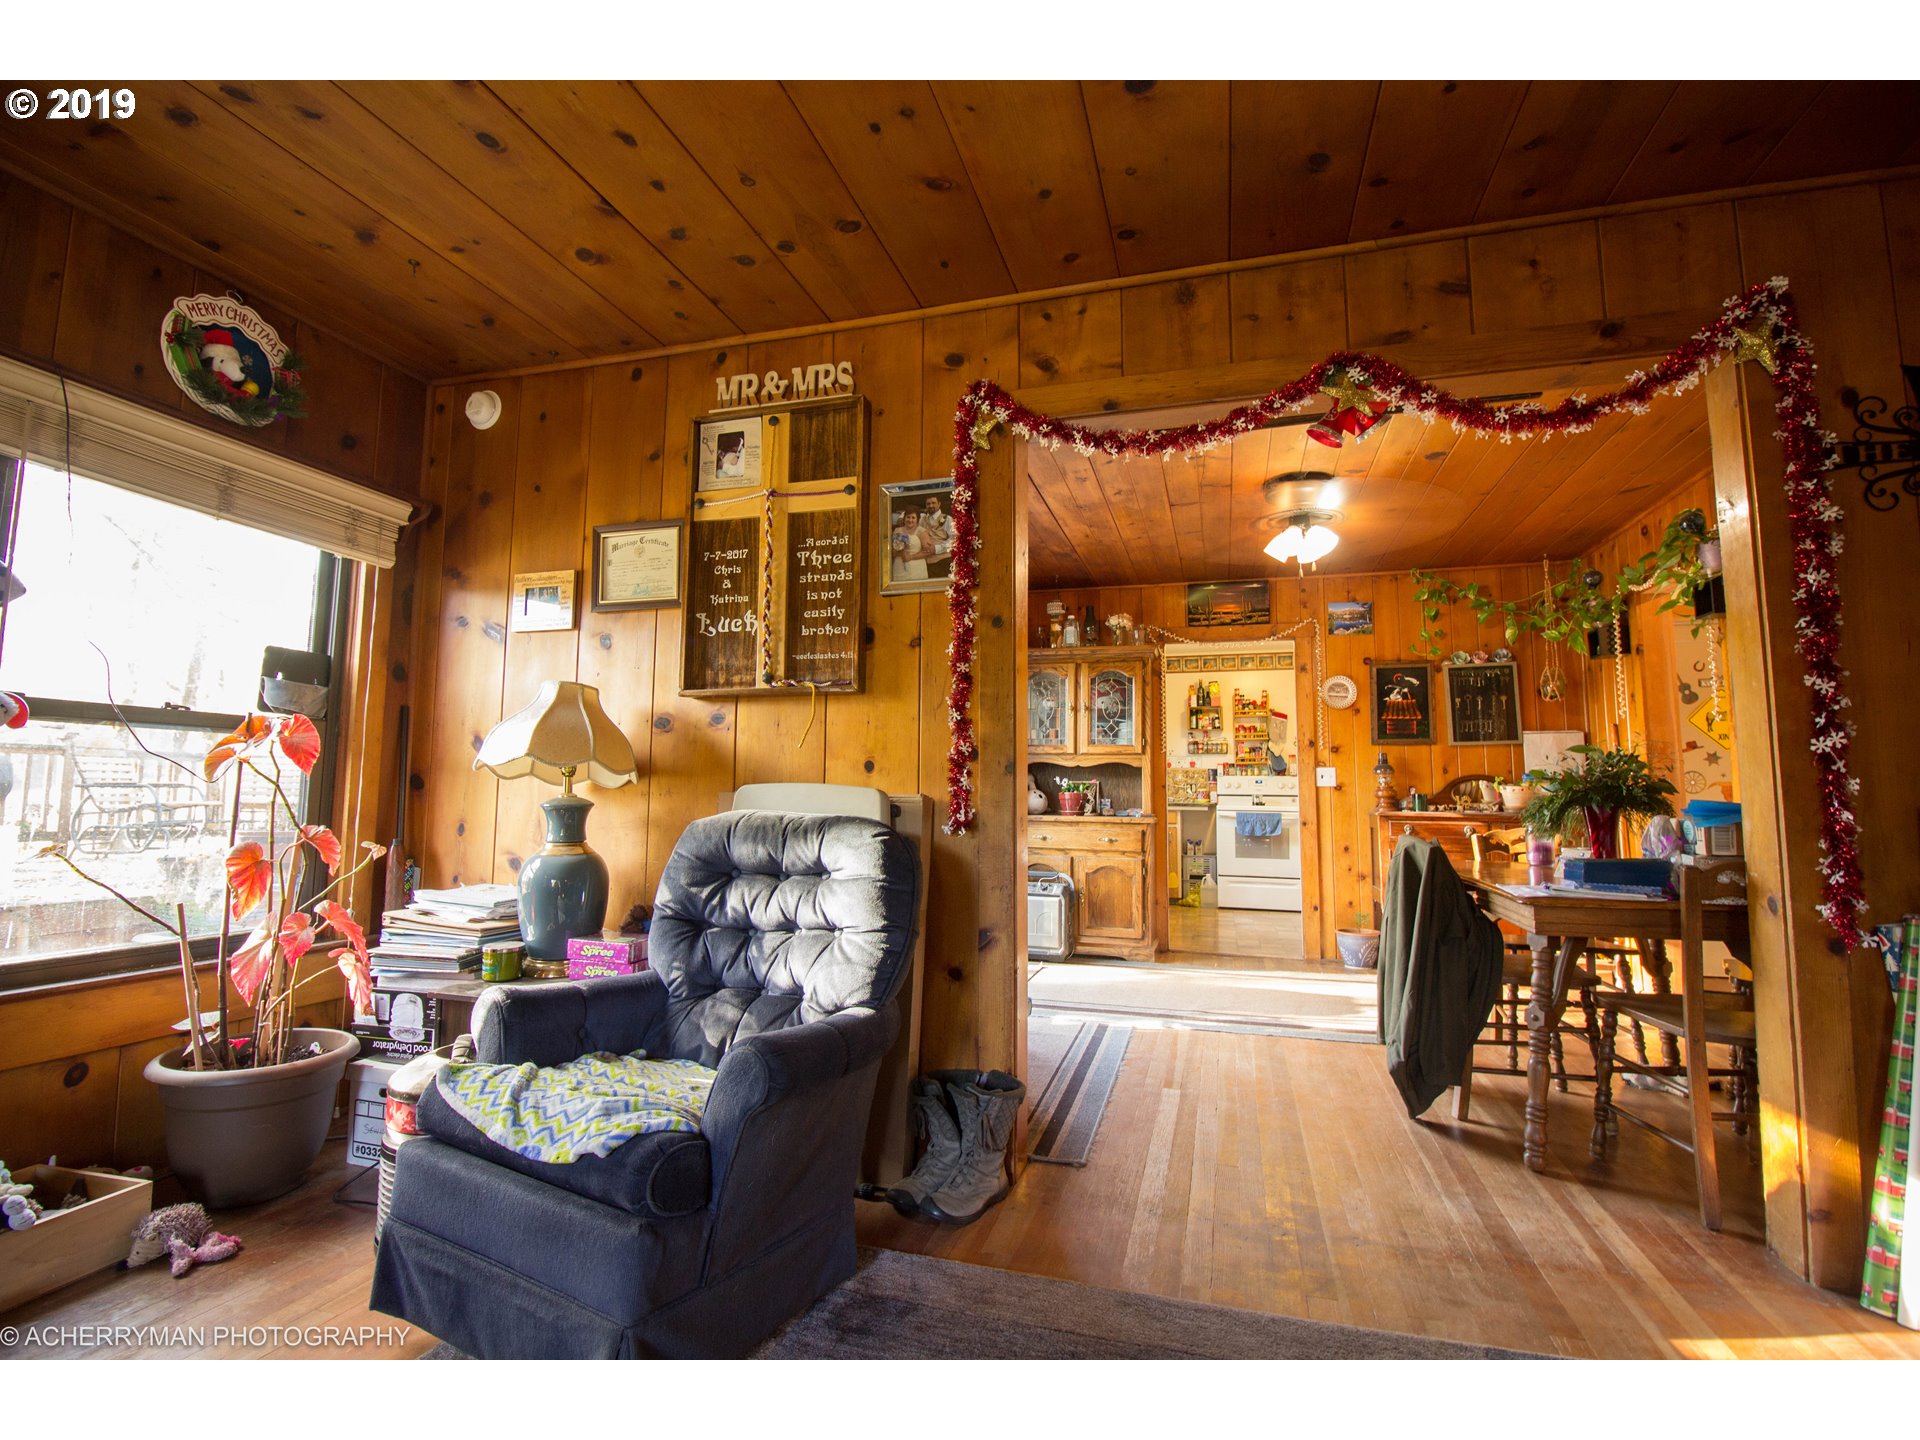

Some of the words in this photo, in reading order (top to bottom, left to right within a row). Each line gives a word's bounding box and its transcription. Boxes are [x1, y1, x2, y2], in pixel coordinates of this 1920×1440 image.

[185, 302, 224, 319] MERRY
[225, 304, 285, 358] CHRISTMAS
[611, 539, 638, 553] Marriage
[639, 535, 669, 547] Certificate
[815, 536, 838, 546] cord
[839, 535, 849, 545] of
[703, 549, 748, 561] 7-7-2017
[796, 550, 853, 569] Three
[714, 565, 742, 576] Chris
[799, 569, 853, 583] strands
[722, 579, 732, 589] &
[710, 594, 749, 606] Katrina
[806, 590, 818, 600] is
[820, 588, 842, 600] not
[803, 605, 845, 619] easily
[801, 623, 849, 636] broken
[581, 945, 615, 957] Spree
[583, 965, 619, 977] Spree
[372, 1040, 412, 1053] Dehydrator
